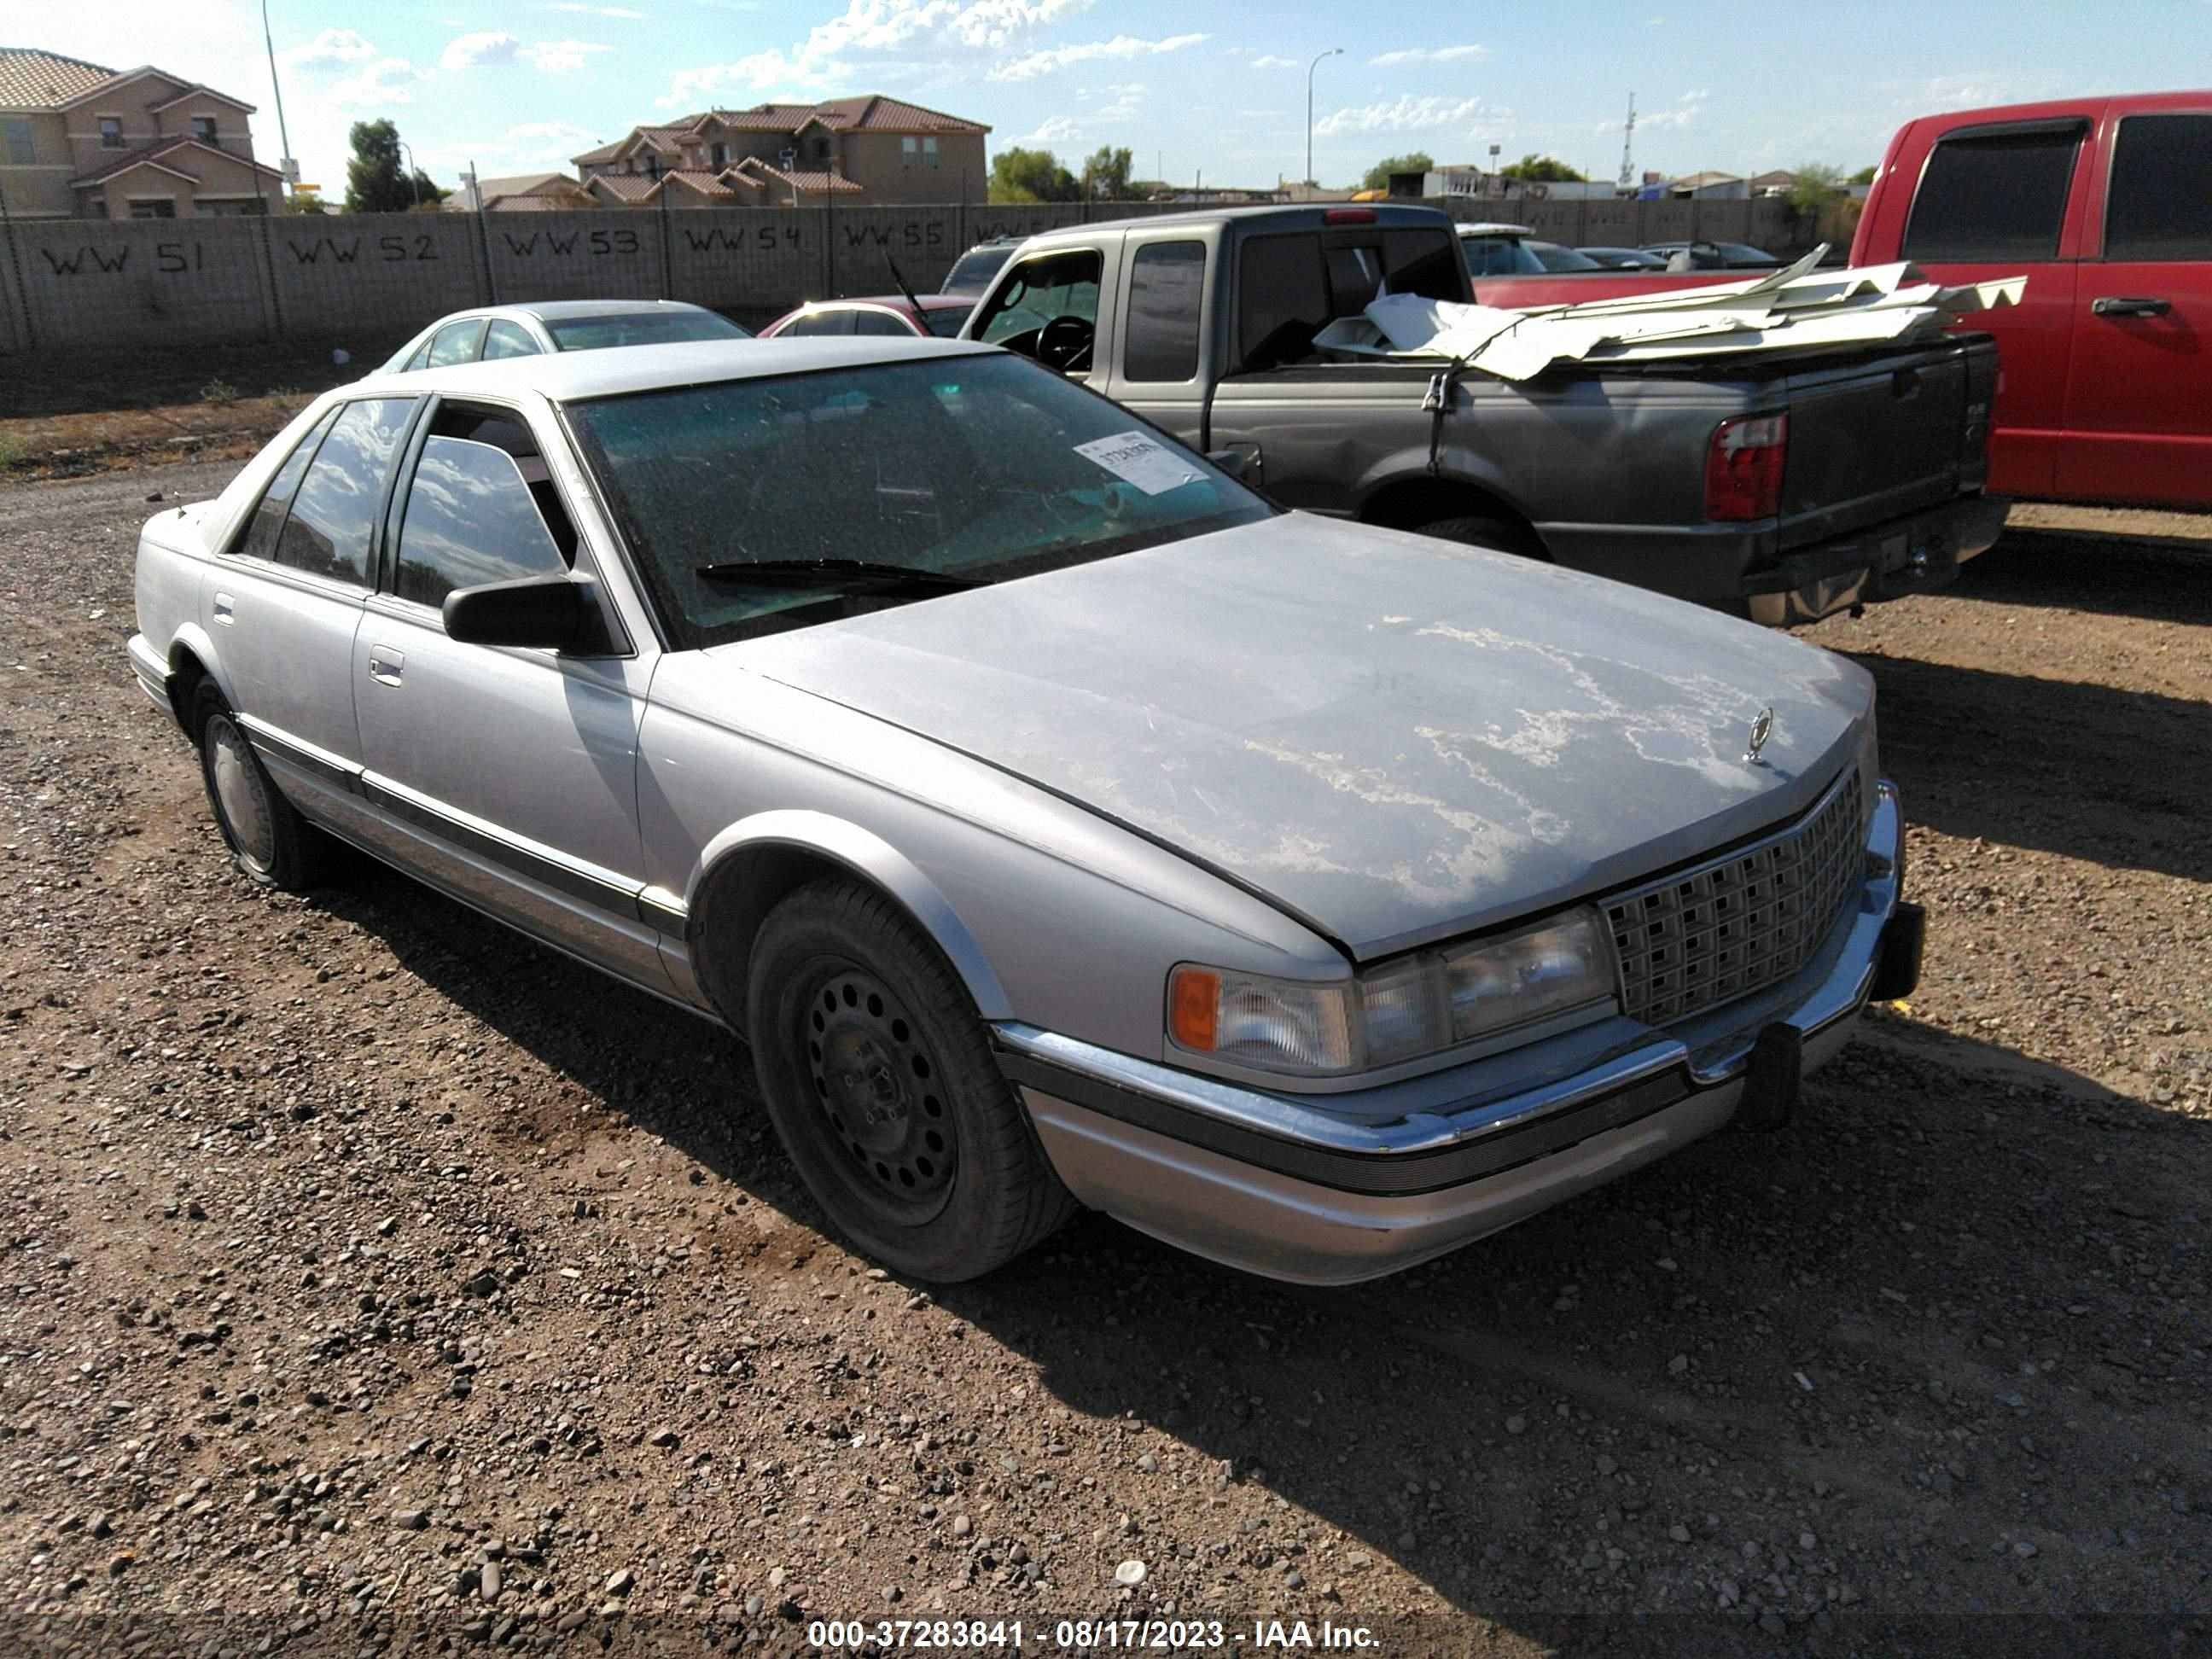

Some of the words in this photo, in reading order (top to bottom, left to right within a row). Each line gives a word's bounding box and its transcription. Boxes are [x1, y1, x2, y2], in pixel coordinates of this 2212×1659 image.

[504, 231, 579, 255] WW
[591, 230, 638, 254] 53
[684, 228, 744, 251] WW
[759, 227, 800, 249] 54
[843, 225, 892, 247] WW
[904, 223, 942, 247] 55
[41, 245, 129, 276] WW
[156, 243, 201, 271] 51
[288, 237, 359, 263] WW
[379, 236, 438, 261] 52
